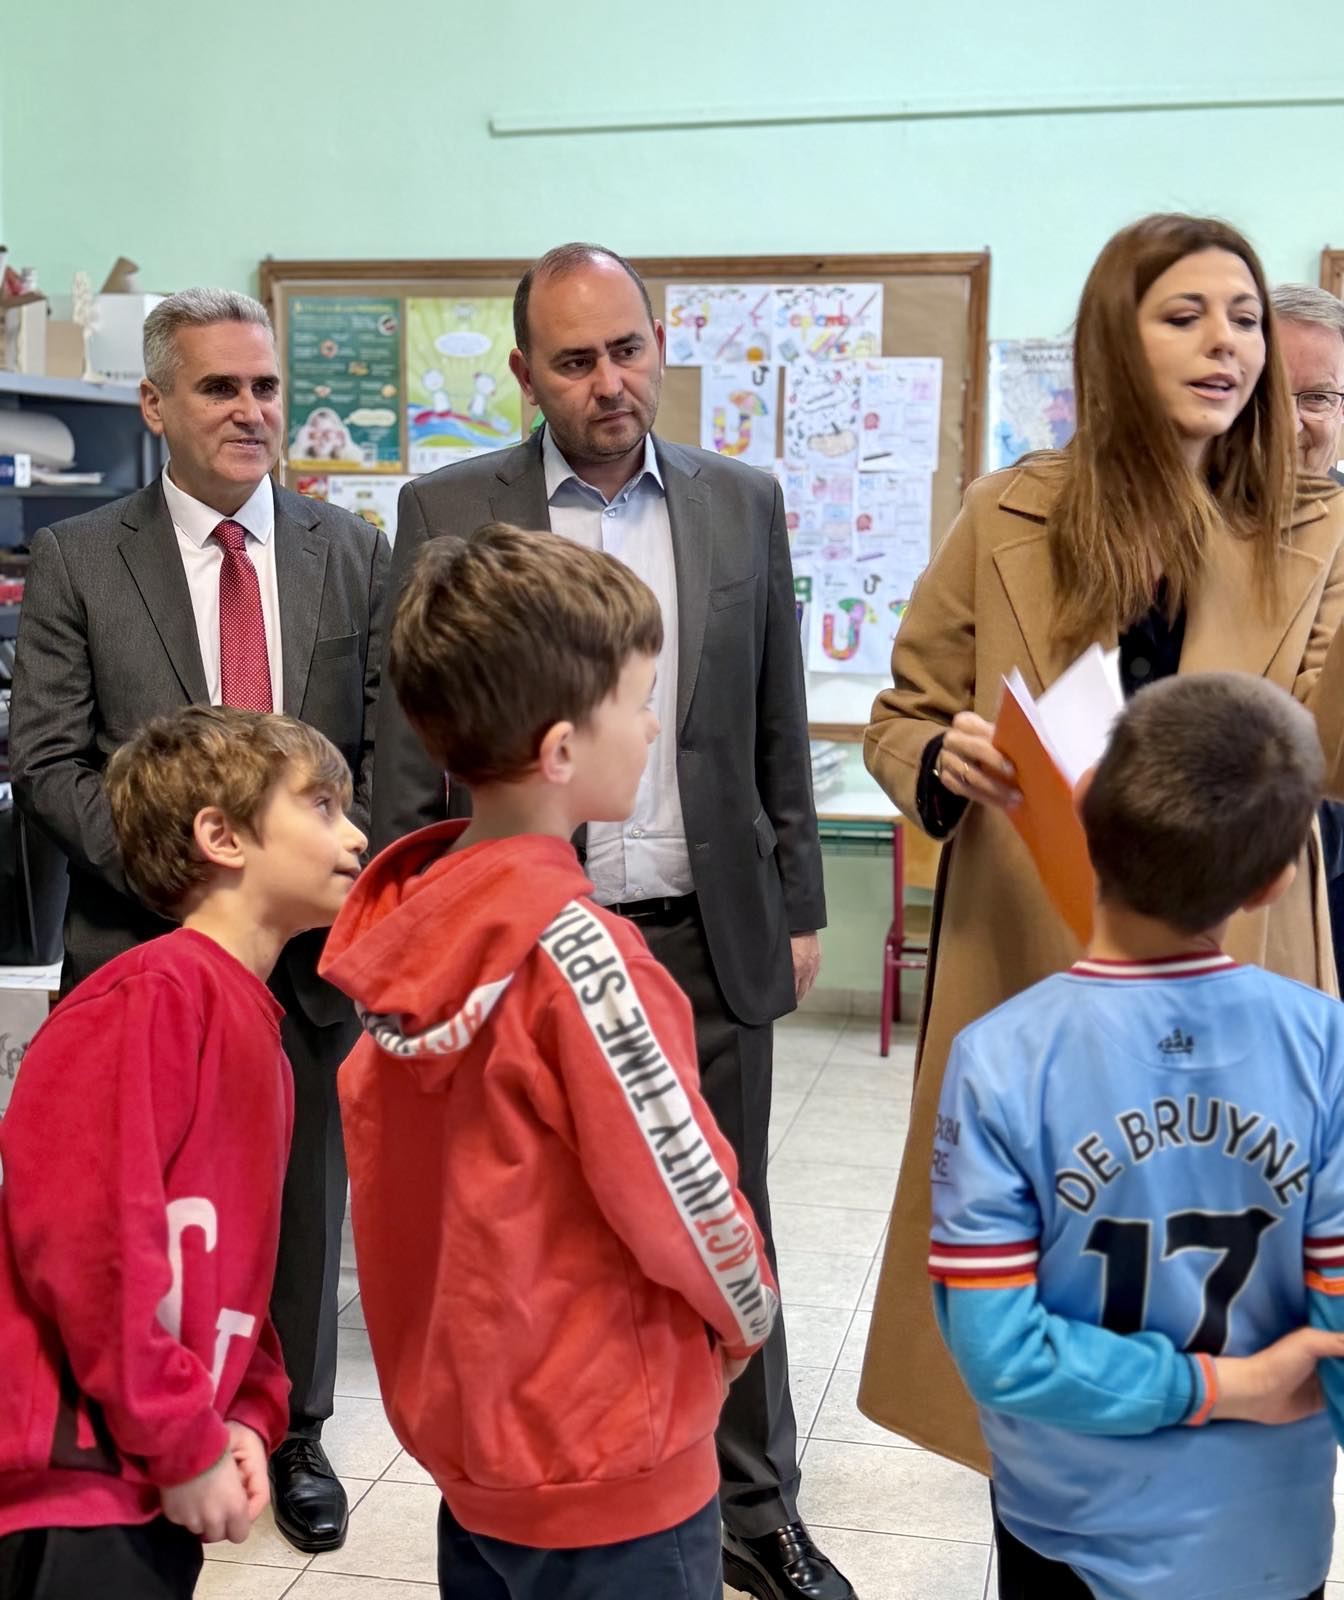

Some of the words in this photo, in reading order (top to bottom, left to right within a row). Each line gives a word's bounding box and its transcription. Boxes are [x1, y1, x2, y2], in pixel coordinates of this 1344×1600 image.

[596, 1007, 677, 1113] TIME
[648, 1116, 754, 1272] ACTIVITY
[1055, 1136, 1123, 1213] DE
[1117, 1096, 1311, 1205] BRUYNE
[1083, 1207, 1280, 1356] 17
